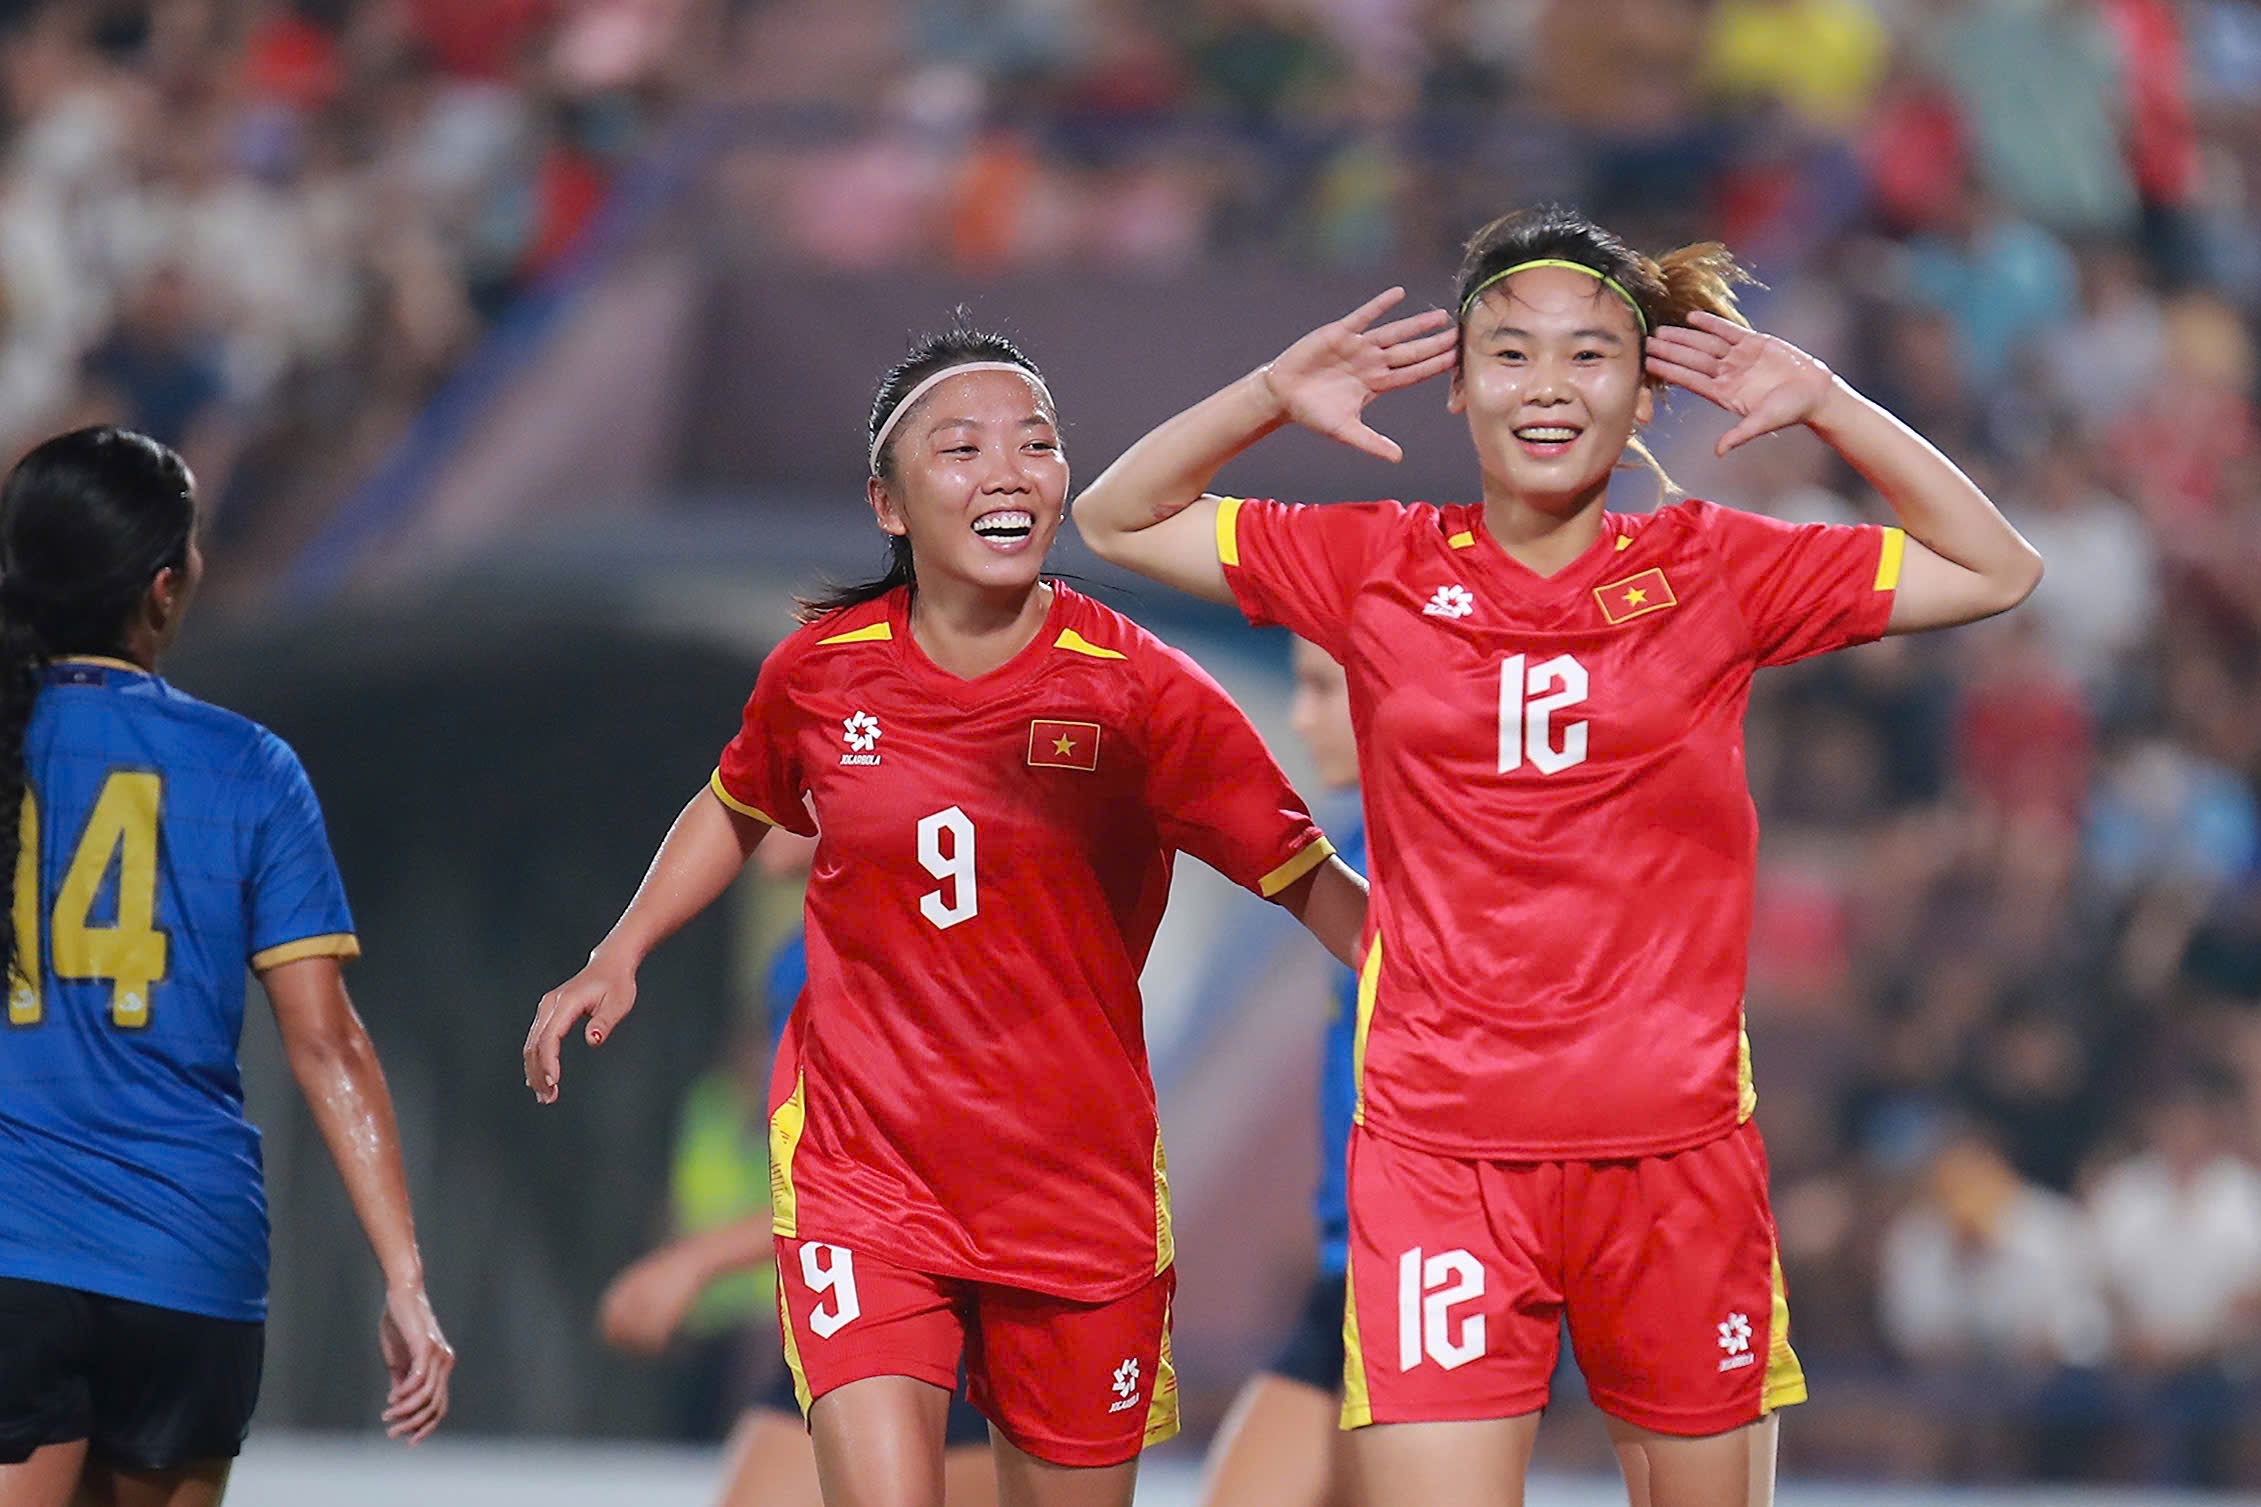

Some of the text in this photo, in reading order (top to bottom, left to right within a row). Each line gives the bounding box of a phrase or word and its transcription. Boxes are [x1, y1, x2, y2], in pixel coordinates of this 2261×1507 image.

[1497, 653, 1589, 776] 12
[8, 771, 168, 1028] 14
[917, 805, 978, 930] 9
[799, 1240, 861, 1340] 9
[1399, 1246, 1487, 1373] 12
